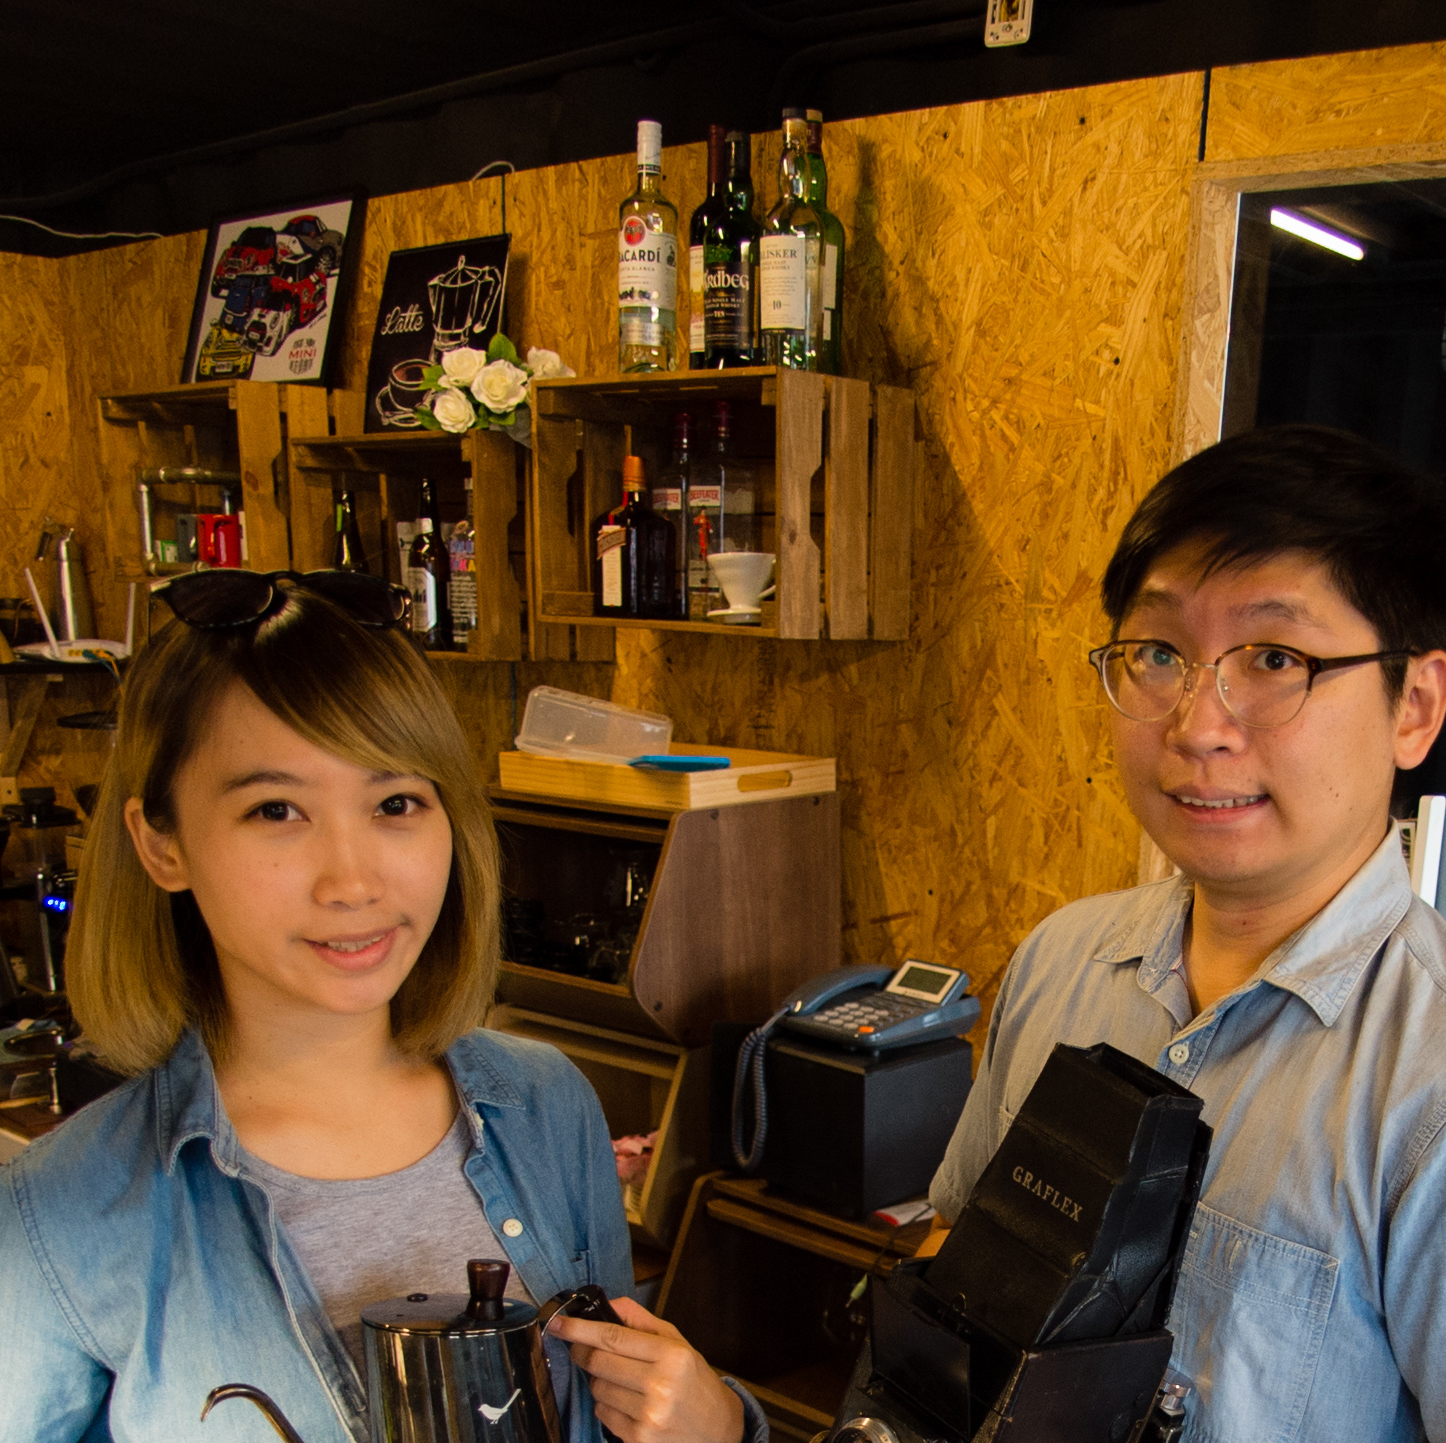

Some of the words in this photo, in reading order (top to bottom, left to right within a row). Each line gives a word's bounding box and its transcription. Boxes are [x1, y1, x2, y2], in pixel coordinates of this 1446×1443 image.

[761, 248, 798, 260] LISKER
[772, 299, 782, 310] 10
[381, 303, 425, 336] Latte
[288, 348, 317, 360] MINI
[1012, 1165, 1084, 1223] GRAFLEX
